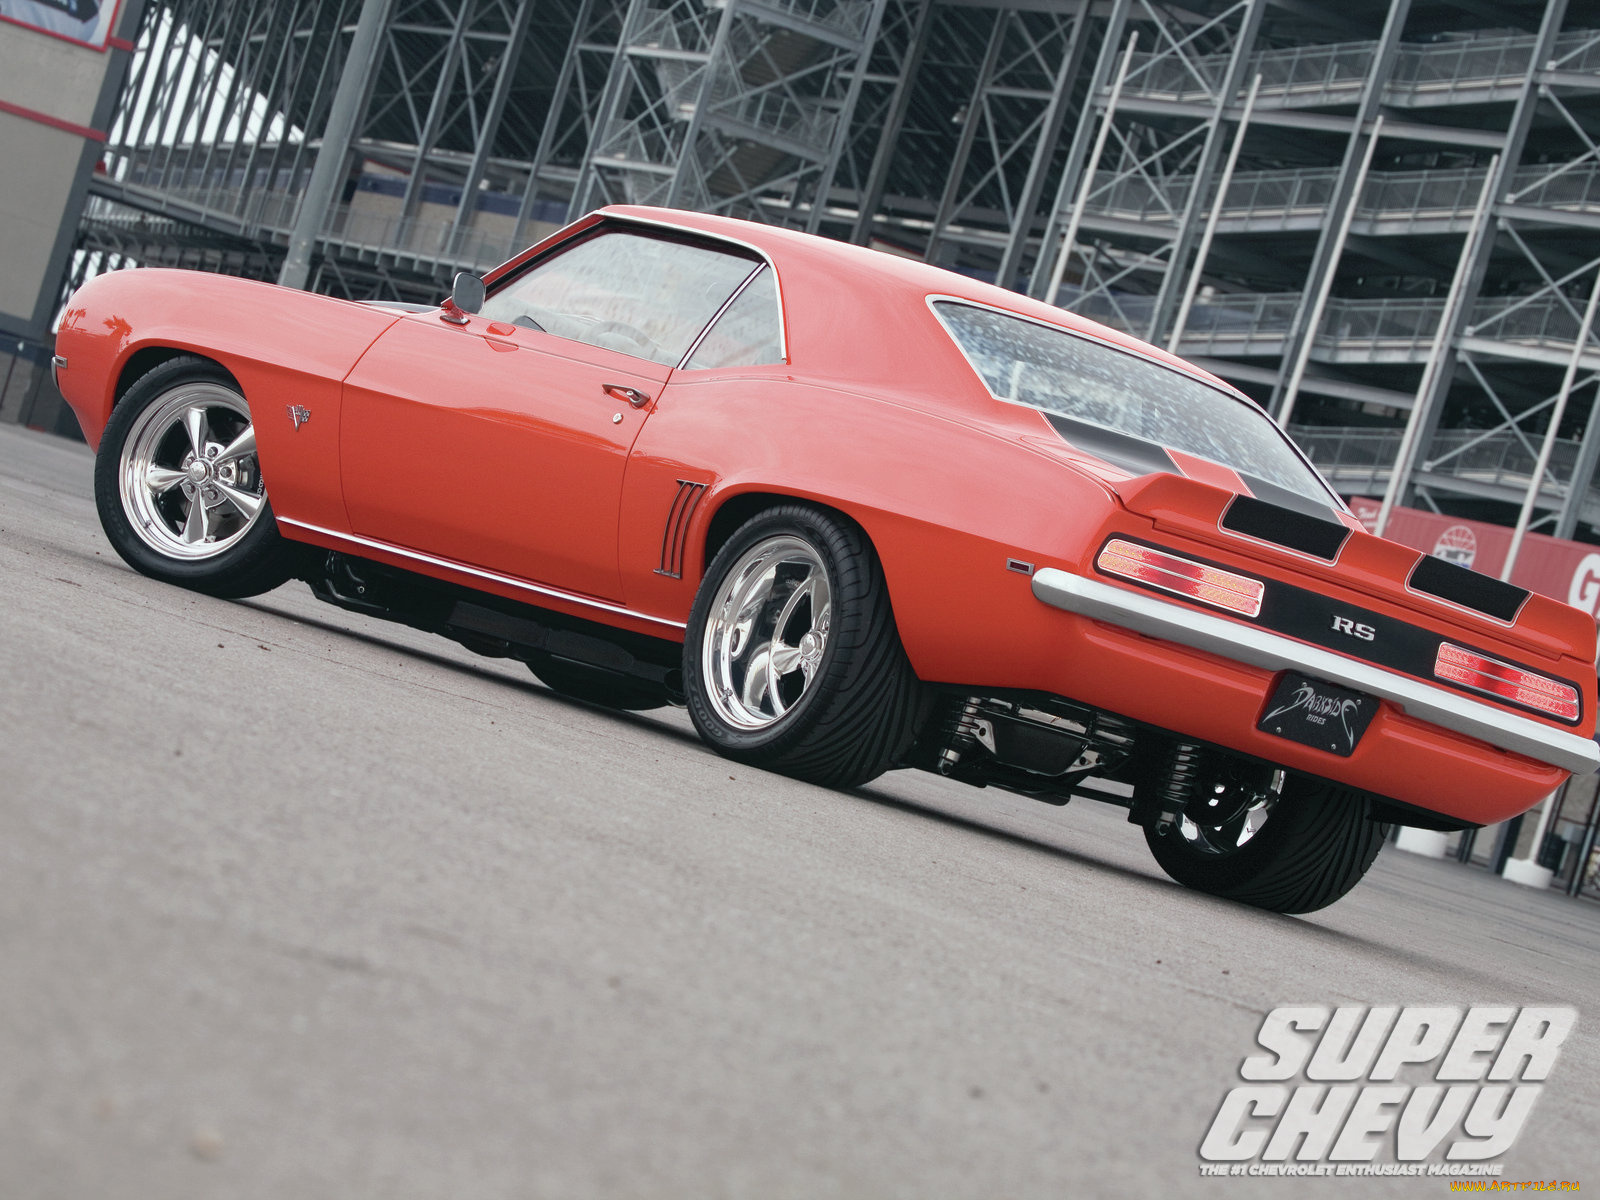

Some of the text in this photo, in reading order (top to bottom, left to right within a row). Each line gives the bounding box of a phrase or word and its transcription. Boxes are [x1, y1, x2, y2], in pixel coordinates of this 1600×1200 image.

[1568, 553, 1600, 619] G
[1332, 615, 1376, 641] RS
[1306, 713, 1326, 725] RIDES
